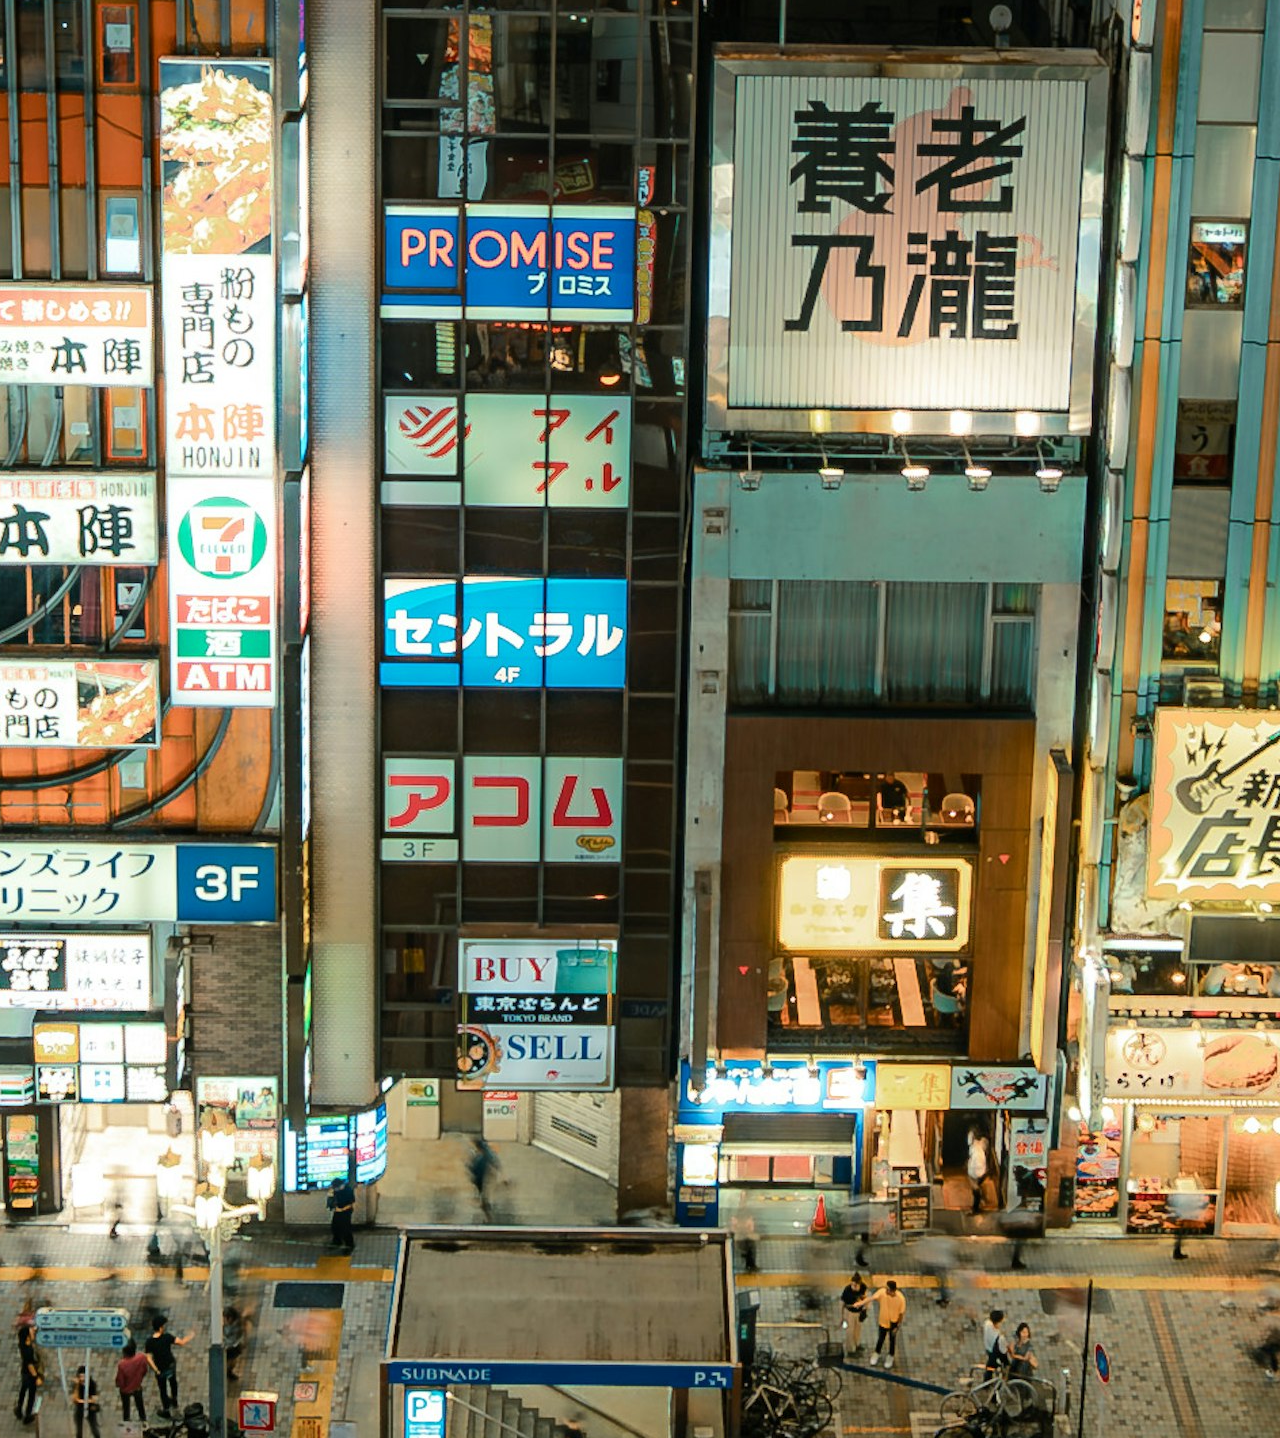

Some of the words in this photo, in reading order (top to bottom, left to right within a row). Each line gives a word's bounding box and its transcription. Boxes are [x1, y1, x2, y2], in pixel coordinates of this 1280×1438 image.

[789, 99, 1026, 215] 養老
[399, 227, 616, 271] PROMISE
[527, 272, 612, 296] プロミス
[785, 230, 1021, 341] 乃瀧
[220, 266, 255, 368] 粉もの
[180, 282, 215, 384] 専門店
[50, 336, 143, 375] 本陣
[175, 402, 265, 443] 本陣
[532, 408, 621, 446] アイ
[181, 446, 261, 468] HONJIN
[100, 482, 149, 497] HONJIN
[185, 597, 261, 623] たばこ
[204, 631, 242, 658] 酒
[386, 608, 624, 657] セントラル
[183, 663, 267, 691] ATM
[493, 666, 521, 684] 4F
[386, 774, 615, 828] アコム
[402, 841, 435, 859] 3F
[194, 864, 260, 903] 3F
[882, 872, 957, 939] 集
[472, 956, 553, 983] BUY
[501, 1013, 537, 1024] TOKYO
[537, 1013, 574, 1024] BRAND
[506, 1035, 603, 1061] SELL
[919, 1071, 946, 1103] 集
[401, 1367, 492, 1382] SUBNADE
[694, 1372, 706, 1385] P
[412, 1396, 428, 1418] P
